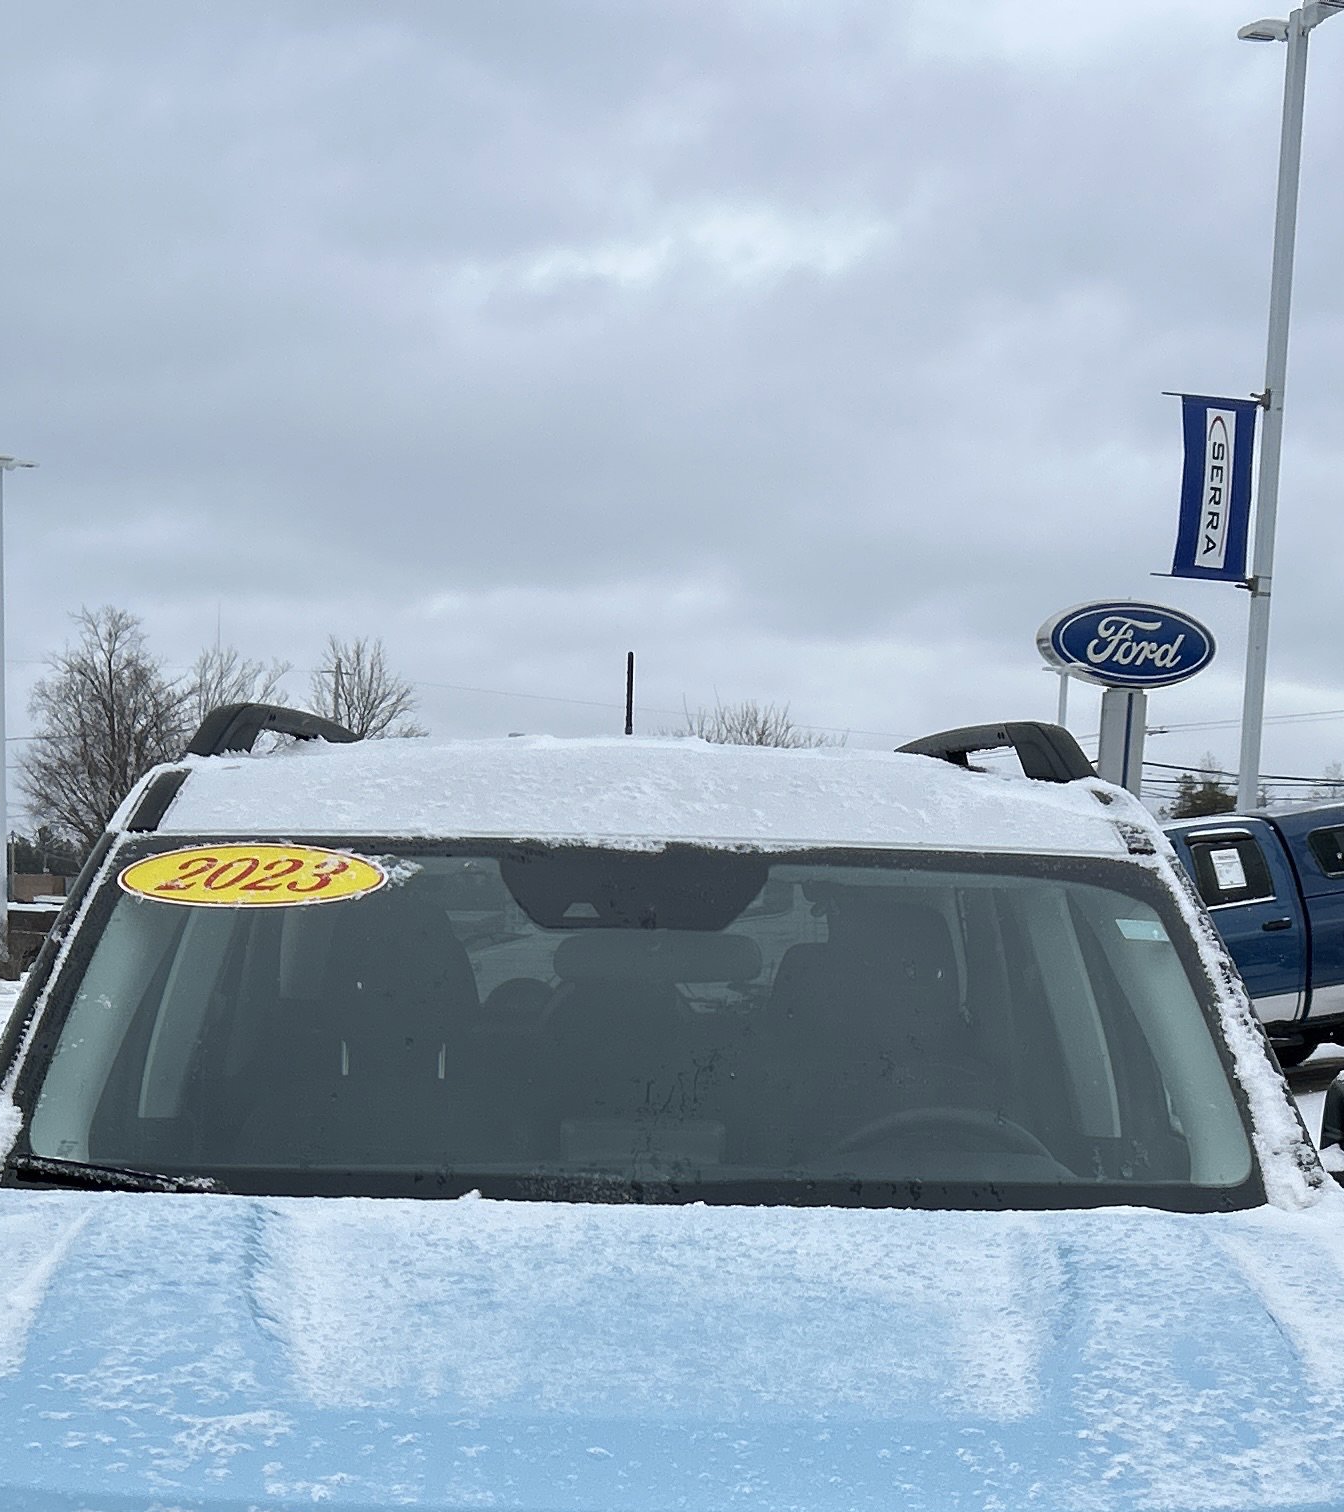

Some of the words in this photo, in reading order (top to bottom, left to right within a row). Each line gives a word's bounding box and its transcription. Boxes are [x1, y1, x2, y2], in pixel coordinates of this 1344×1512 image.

[1202, 441, 1224, 555] SERRA
[1086, 615, 1185, 669] Ford
[153, 856, 350, 893] 2023
